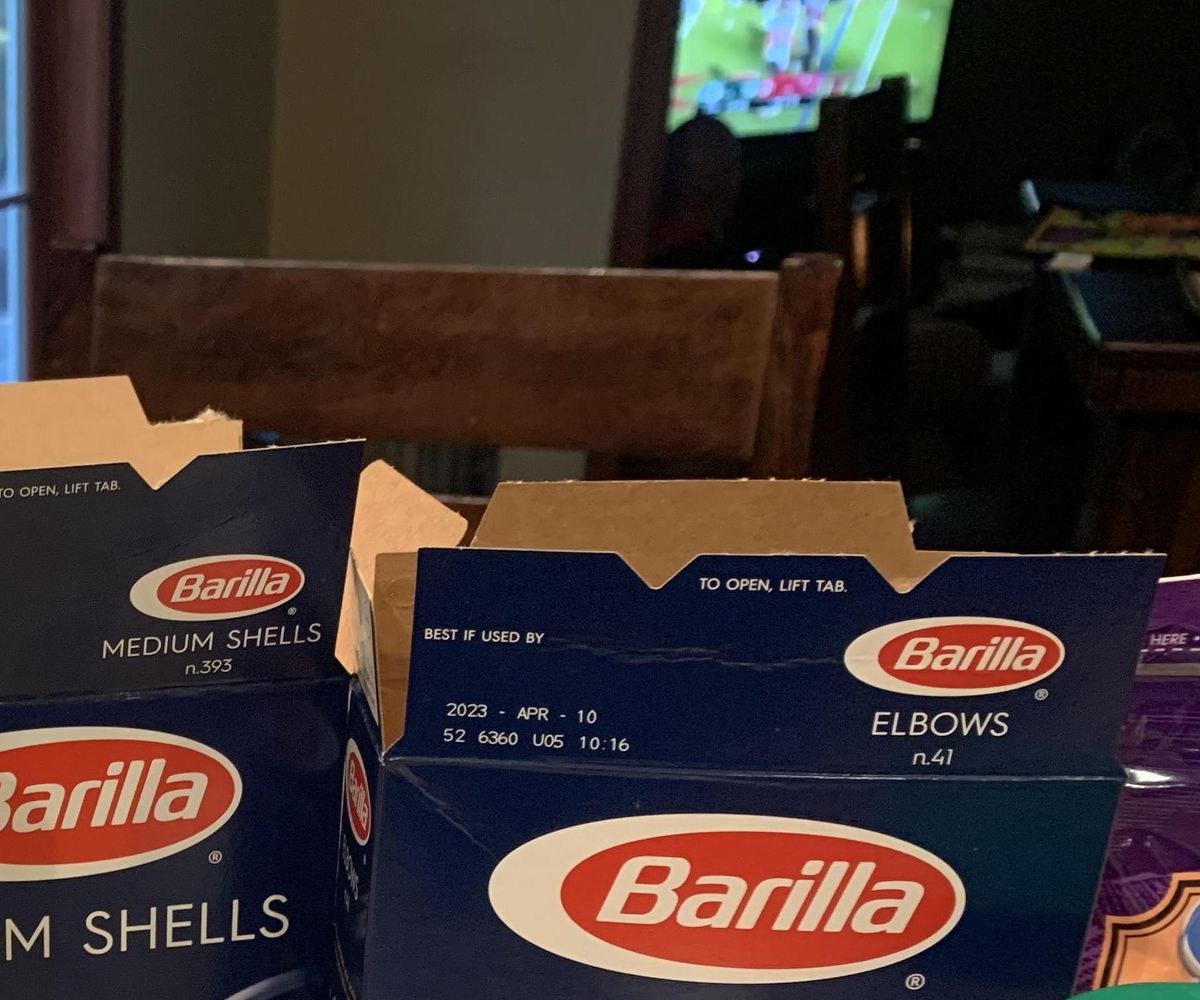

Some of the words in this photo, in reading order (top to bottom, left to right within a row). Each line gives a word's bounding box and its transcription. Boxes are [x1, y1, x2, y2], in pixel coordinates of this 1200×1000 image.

[19, 485, 60, 498] OPEN,
[64, 482, 90, 496] LIFT
[94, 480, 121, 493] TAB.
[170, 567, 291, 604] Barilla
[700, 577, 720, 591] TO
[726, 578, 773, 594] OPEN,
[779, 579, 810, 593] LIFT
[816, 579, 847, 593] TAB.
[102, 631, 214, 660] MEDIUM
[226, 622, 322, 651] SHELLS
[424, 628, 458, 642] BEST
[464, 629, 476, 642] IF
[482, 630, 520, 643] USED
[526, 631, 545, 644] BY
[1150, 632, 1189, 646] HERE
[893, 636, 1047, 672] Barilla
[185, 658, 233, 676] n.393
[446, 703, 488, 719] 2023
[517, 706, 549, 722] APR
[577, 709, 597, 724] 10
[872, 711, 1010, 737] ELBOWS
[443, 728, 466, 743] 52
[478, 730, 518, 746] 6360
[912, 748, 953, 766] n.41
[596, 855, 925, 934] Barilla
[83, 893, 289, 955] SHELLS
